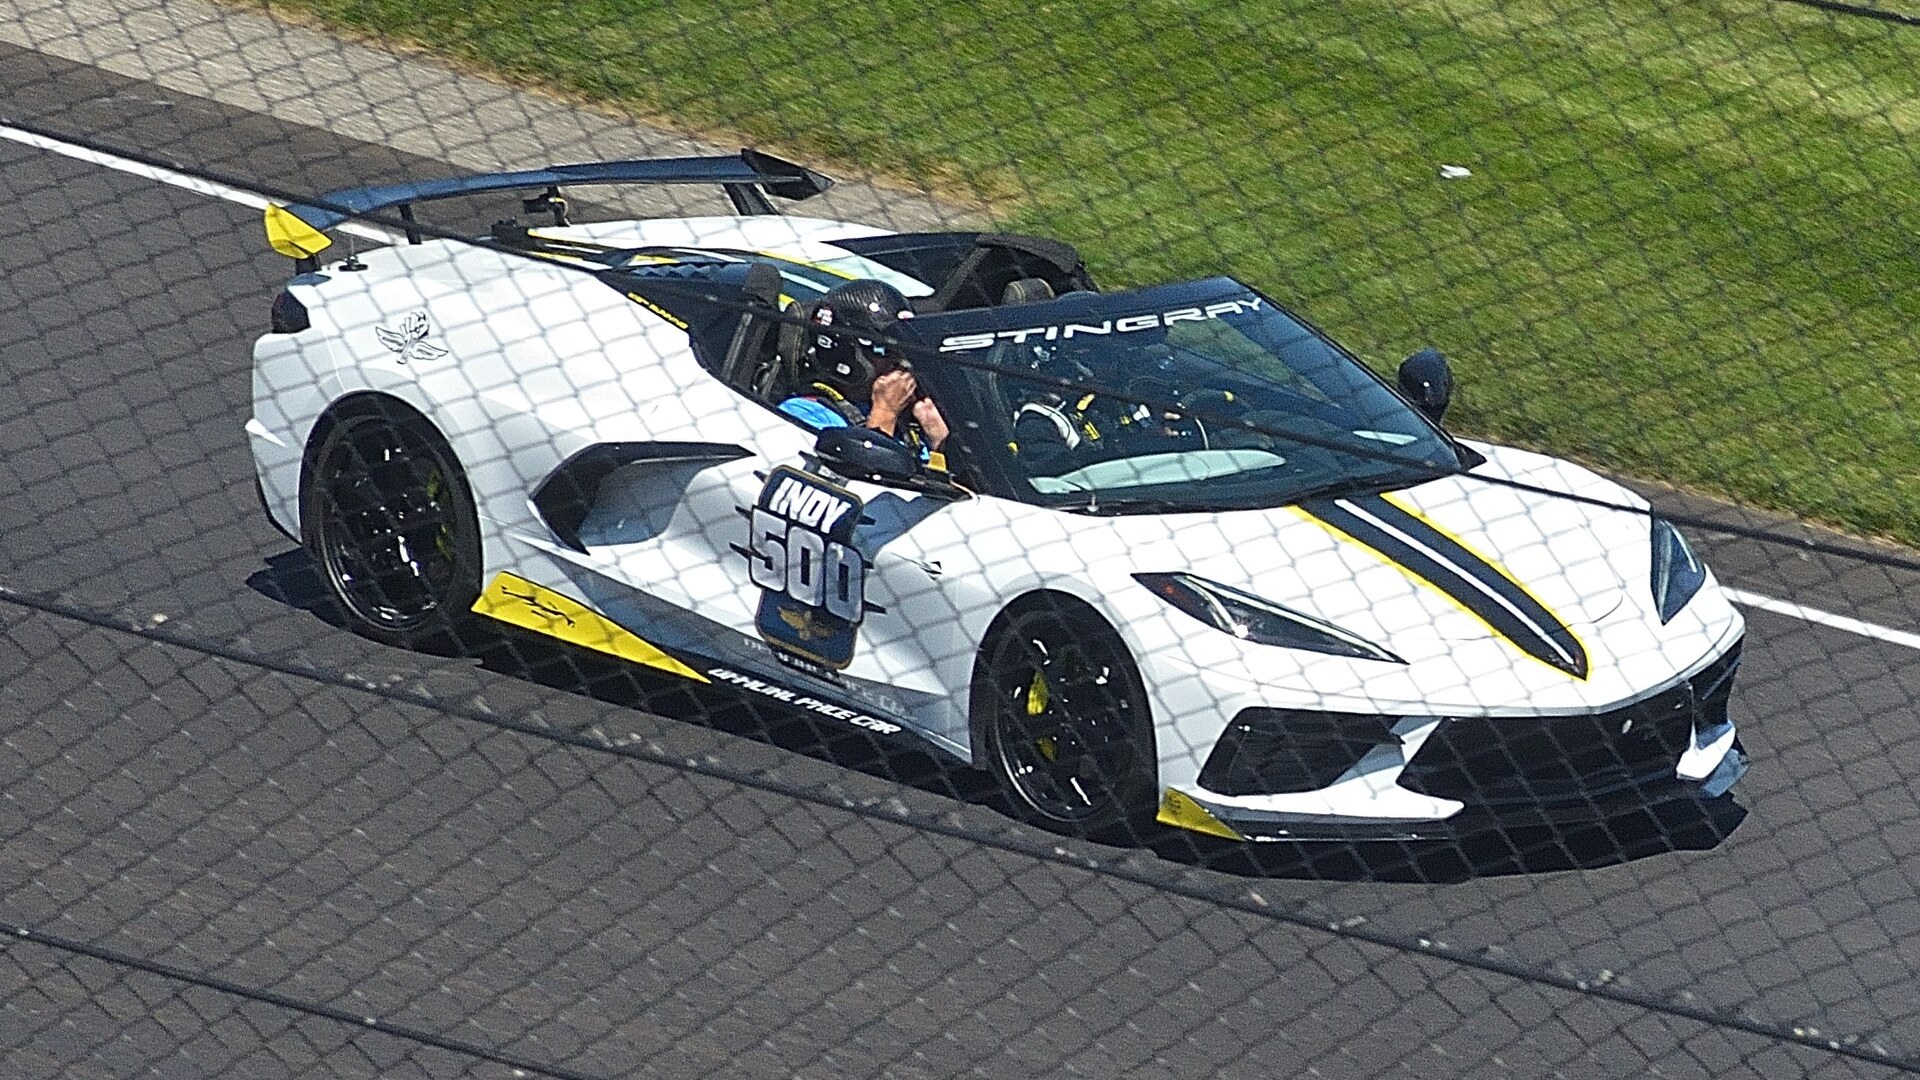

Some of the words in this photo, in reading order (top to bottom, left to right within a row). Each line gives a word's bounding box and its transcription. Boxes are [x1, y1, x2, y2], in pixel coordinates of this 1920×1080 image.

[939, 296, 1262, 353] STINGRAY
[768, 476, 852, 534] INDY
[750, 507, 864, 624] 500
[849, 715, 902, 735] CAR
